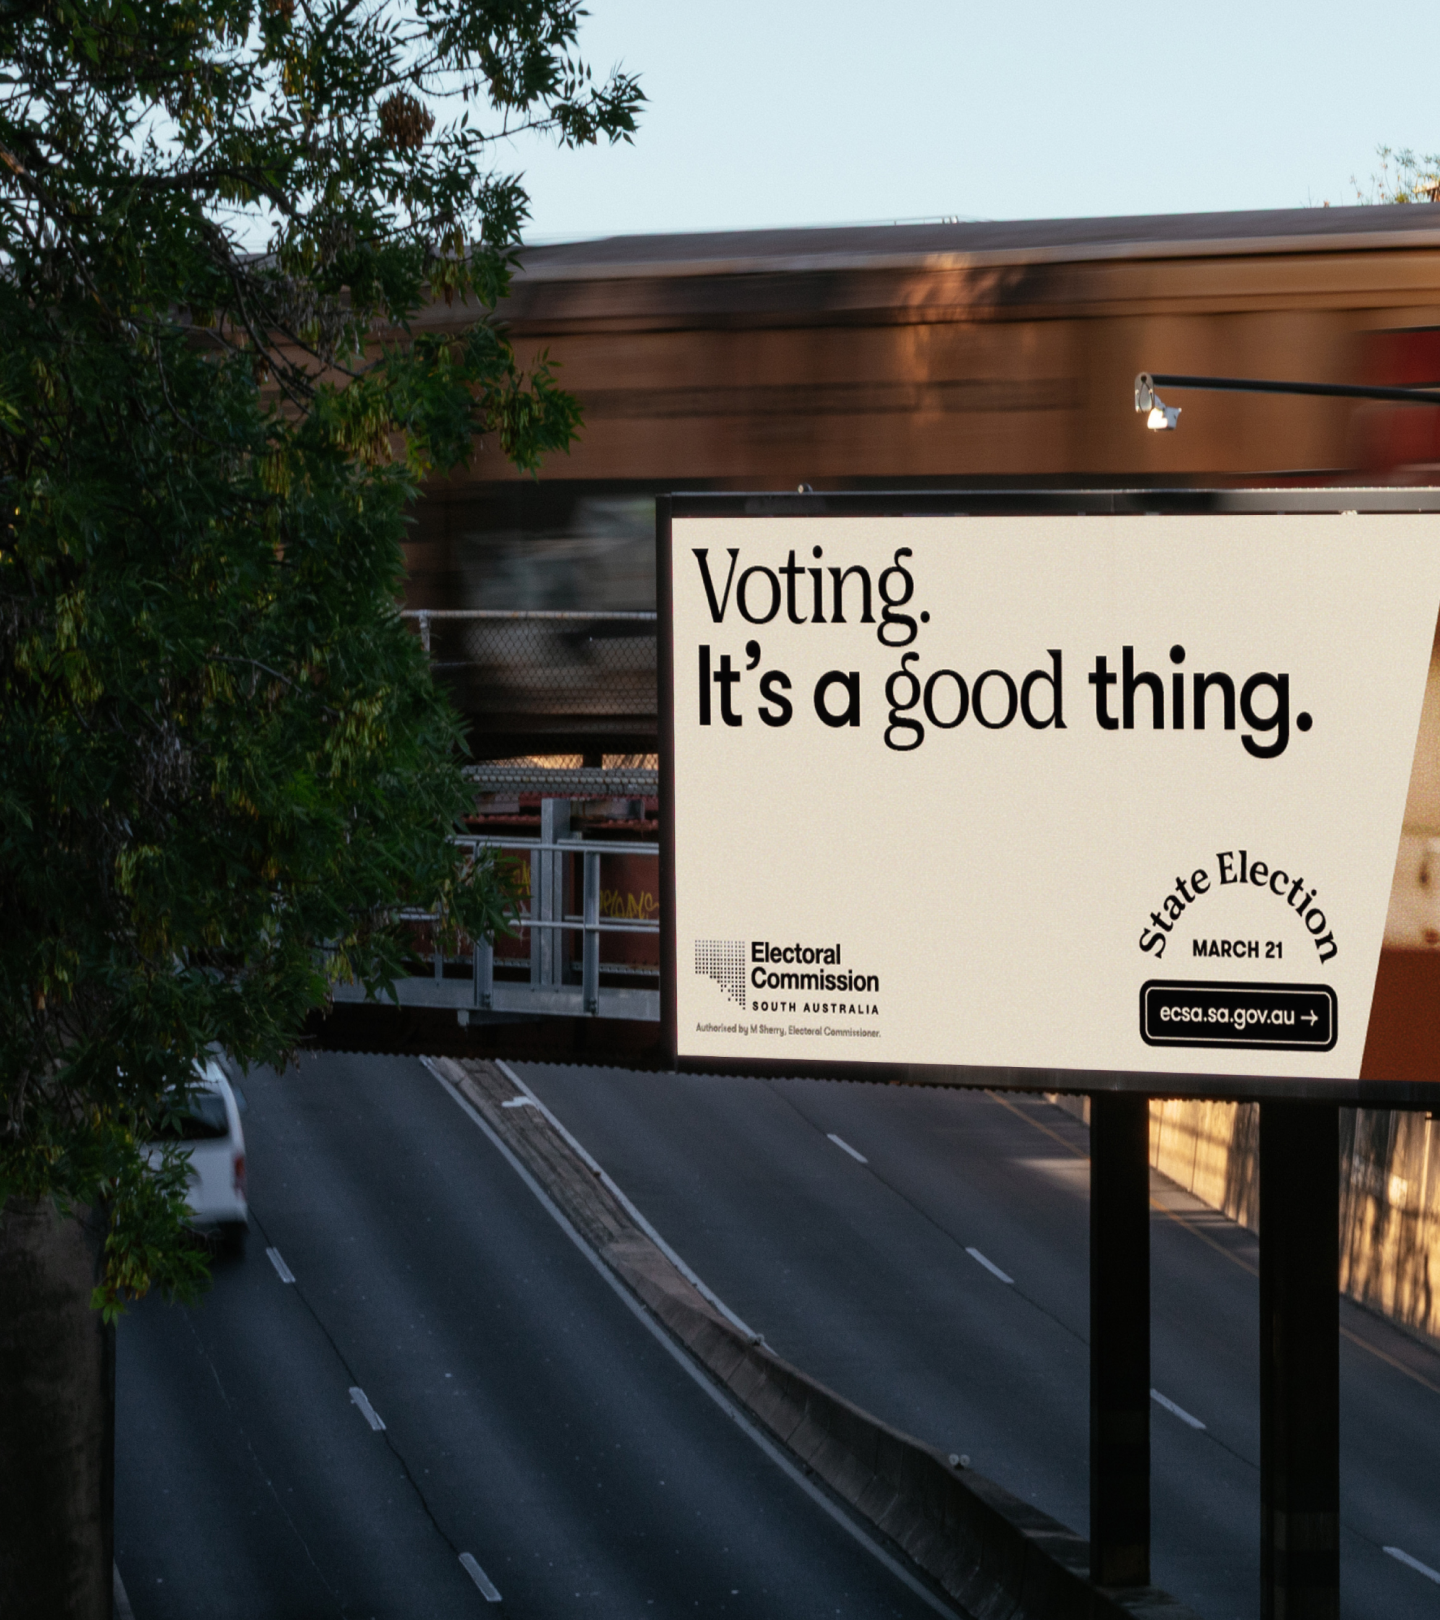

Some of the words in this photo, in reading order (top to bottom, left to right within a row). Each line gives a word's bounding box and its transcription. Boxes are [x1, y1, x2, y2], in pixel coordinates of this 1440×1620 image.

[692, 545, 931, 648] Voting.
[813, 670, 861, 728] a
[883, 649, 1068, 752] good
[1088, 644, 1313, 759] thing.
[1138, 868, 1211, 959] State
[1215, 849, 1338, 965] Election
[751, 941, 841, 966] Electoral
[1192, 939, 1260, 959] MARCH
[1265, 940, 1283, 959] 21
[751, 966, 880, 993] Commission
[752, 1000, 797, 1012] SOUTH
[803, 1002, 880, 1016] AUSTRALIA
[1159, 1005, 1296, 1030] ecsa.sa.gov.au
[695, 1022, 737, 1034] Authorised
[738, 1024, 749, 1036] by
[750, 1024, 758, 1034] M
[759, 1024, 787, 1037] Sherry,
[788, 1025, 823, 1036] Electoral
[823, 1026, 882, 1039] Commissioner.
